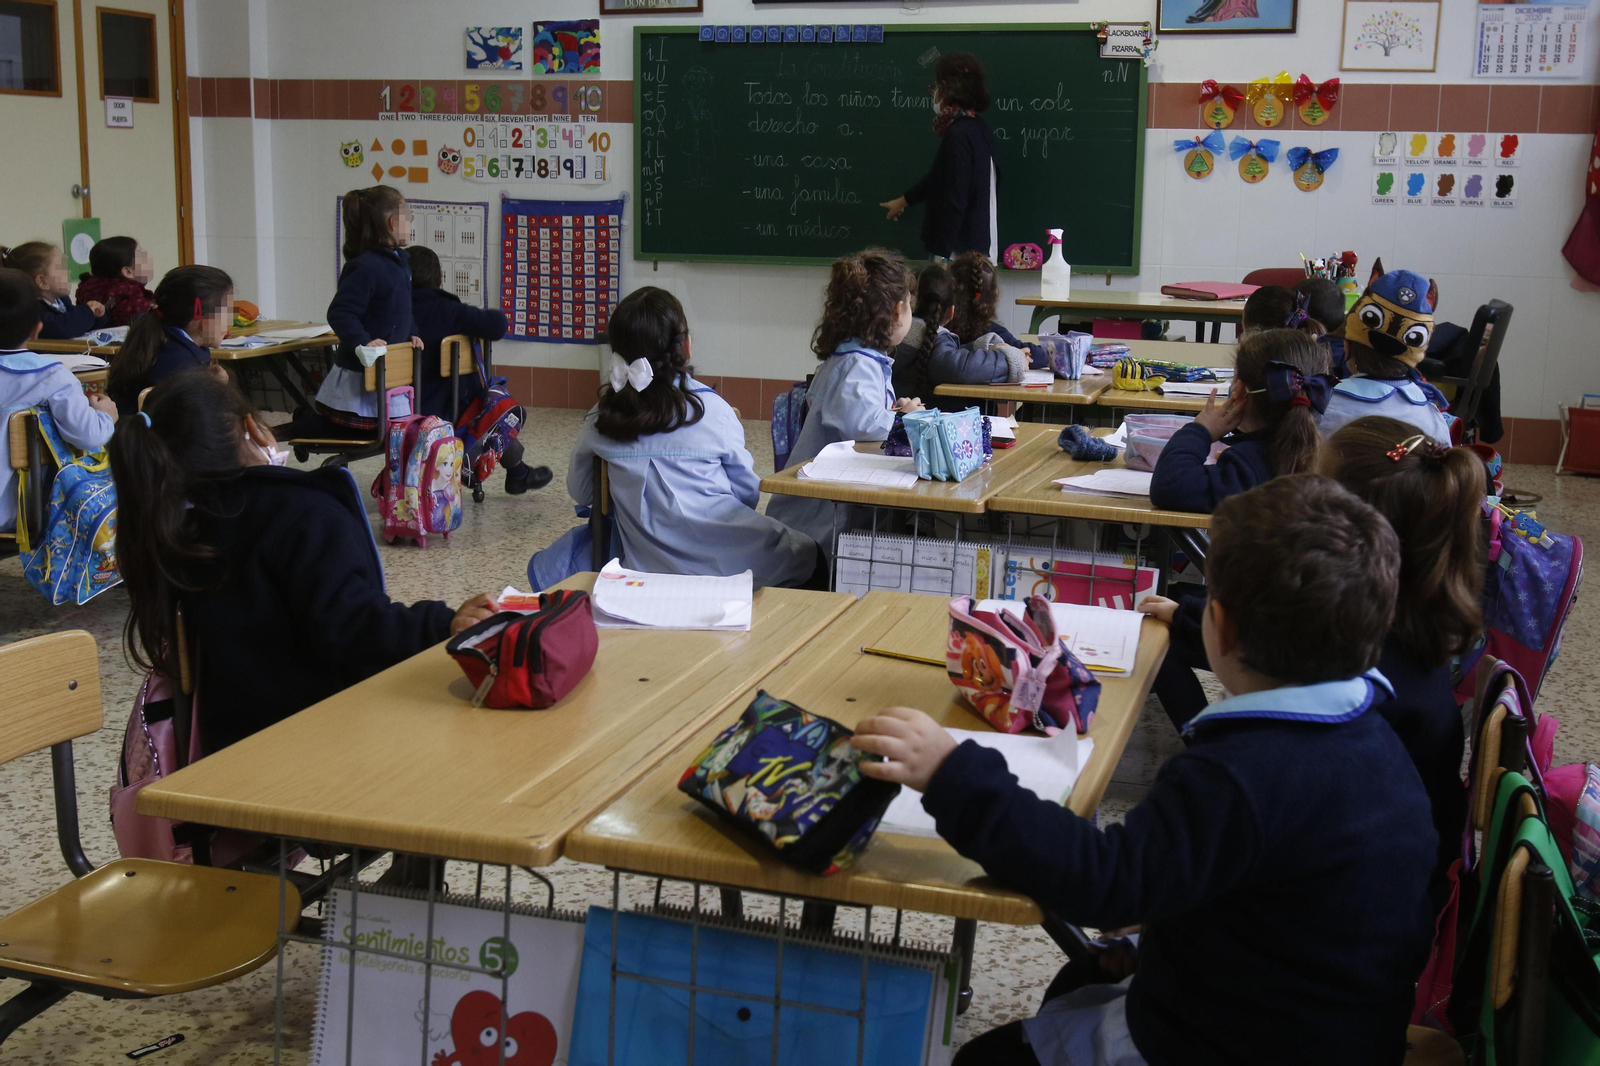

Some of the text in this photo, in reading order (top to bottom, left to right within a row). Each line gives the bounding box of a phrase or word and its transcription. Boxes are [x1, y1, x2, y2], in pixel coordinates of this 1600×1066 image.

[380, 84, 603, 112] 1 2 3 4 5 6 7 8 9 10
[744, 82, 793, 104] Todos
[802, 82, 829, 106] los
[838, 90, 882, 108] niños
[997, 82, 1074, 112] un cole
[748, 106, 819, 134] derecho
[463, 127, 611, 152] 0 1 2 3 4 10
[993, 123, 1075, 158] a jugar
[463, 157, 574, 179] 5 6 7 8 9
[801, 155, 852, 170] casa
[790, 174, 862, 216] familia
[786, 215, 850, 239] médico
[484, 942, 503, 971] 5
